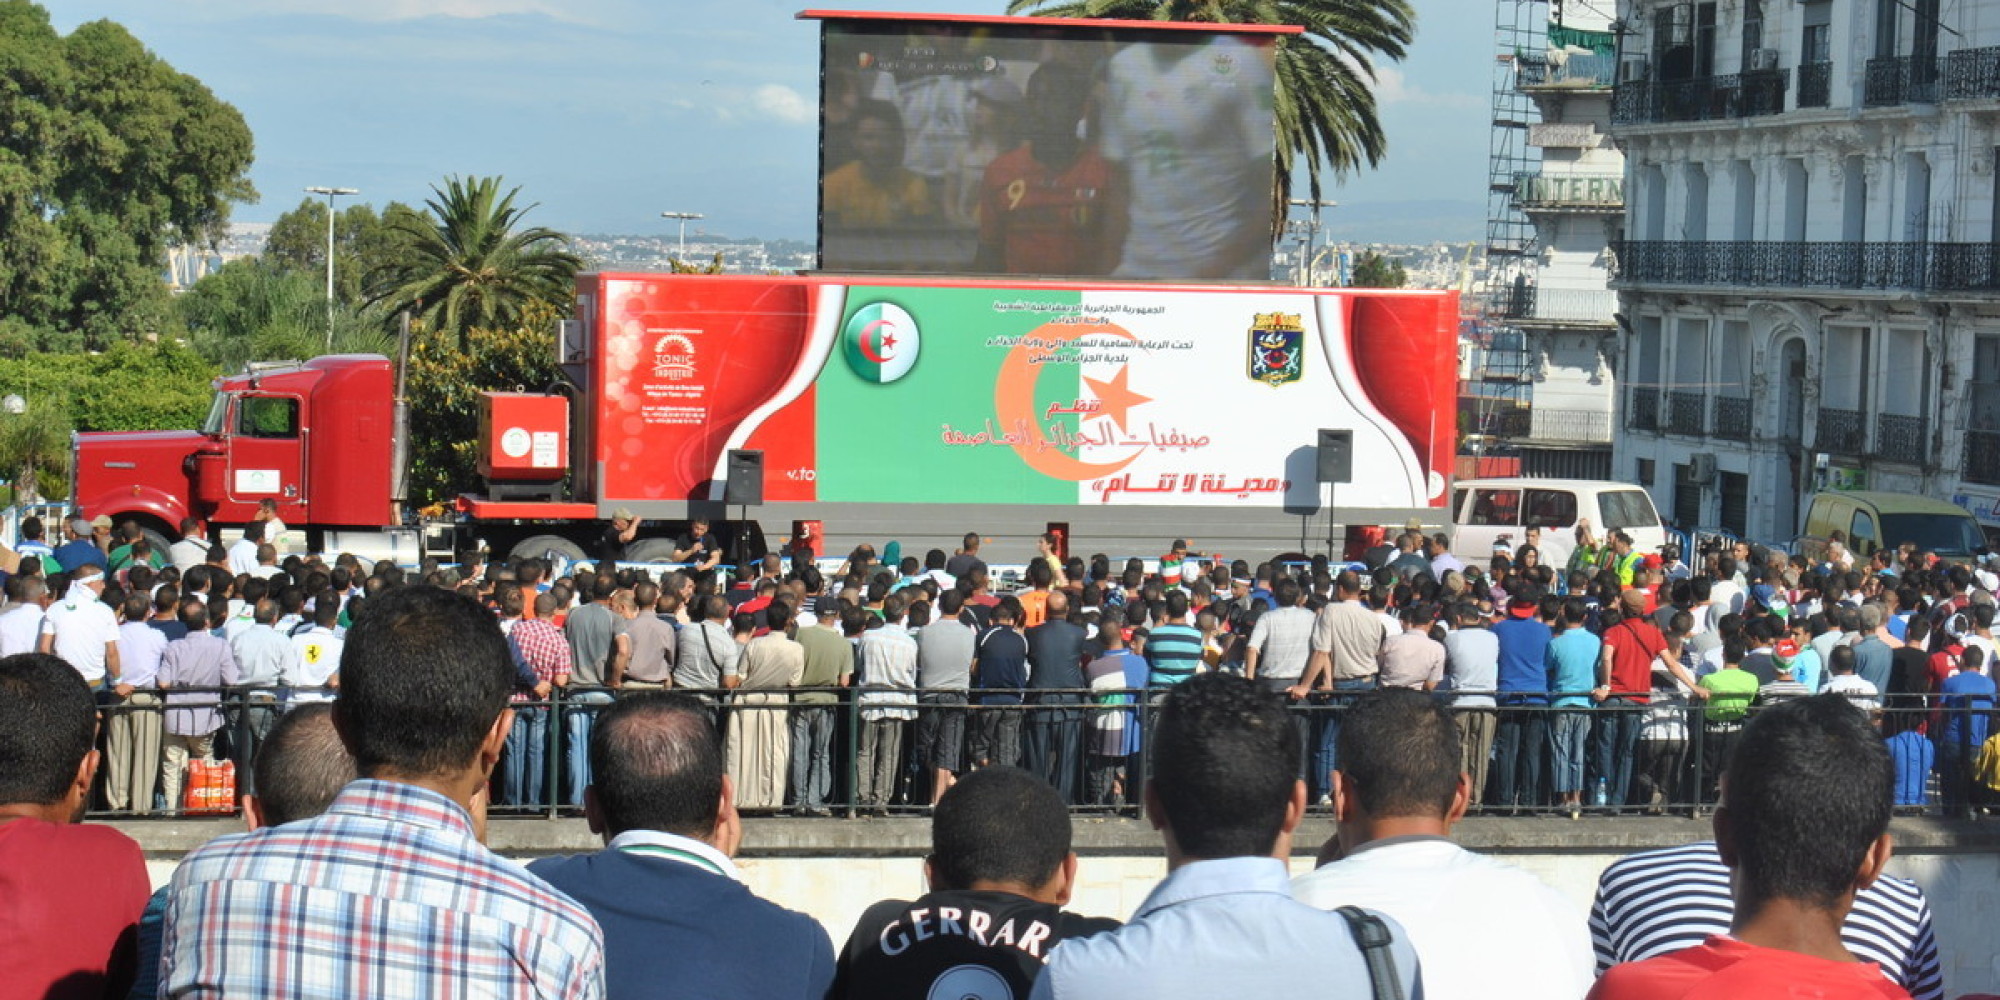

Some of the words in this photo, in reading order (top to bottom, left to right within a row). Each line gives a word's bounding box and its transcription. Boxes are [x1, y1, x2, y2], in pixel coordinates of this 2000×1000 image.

[1008, 179, 1025, 211] 9
[655, 354, 694, 364] TONIC
[880, 905, 1050, 965] GERRAR
